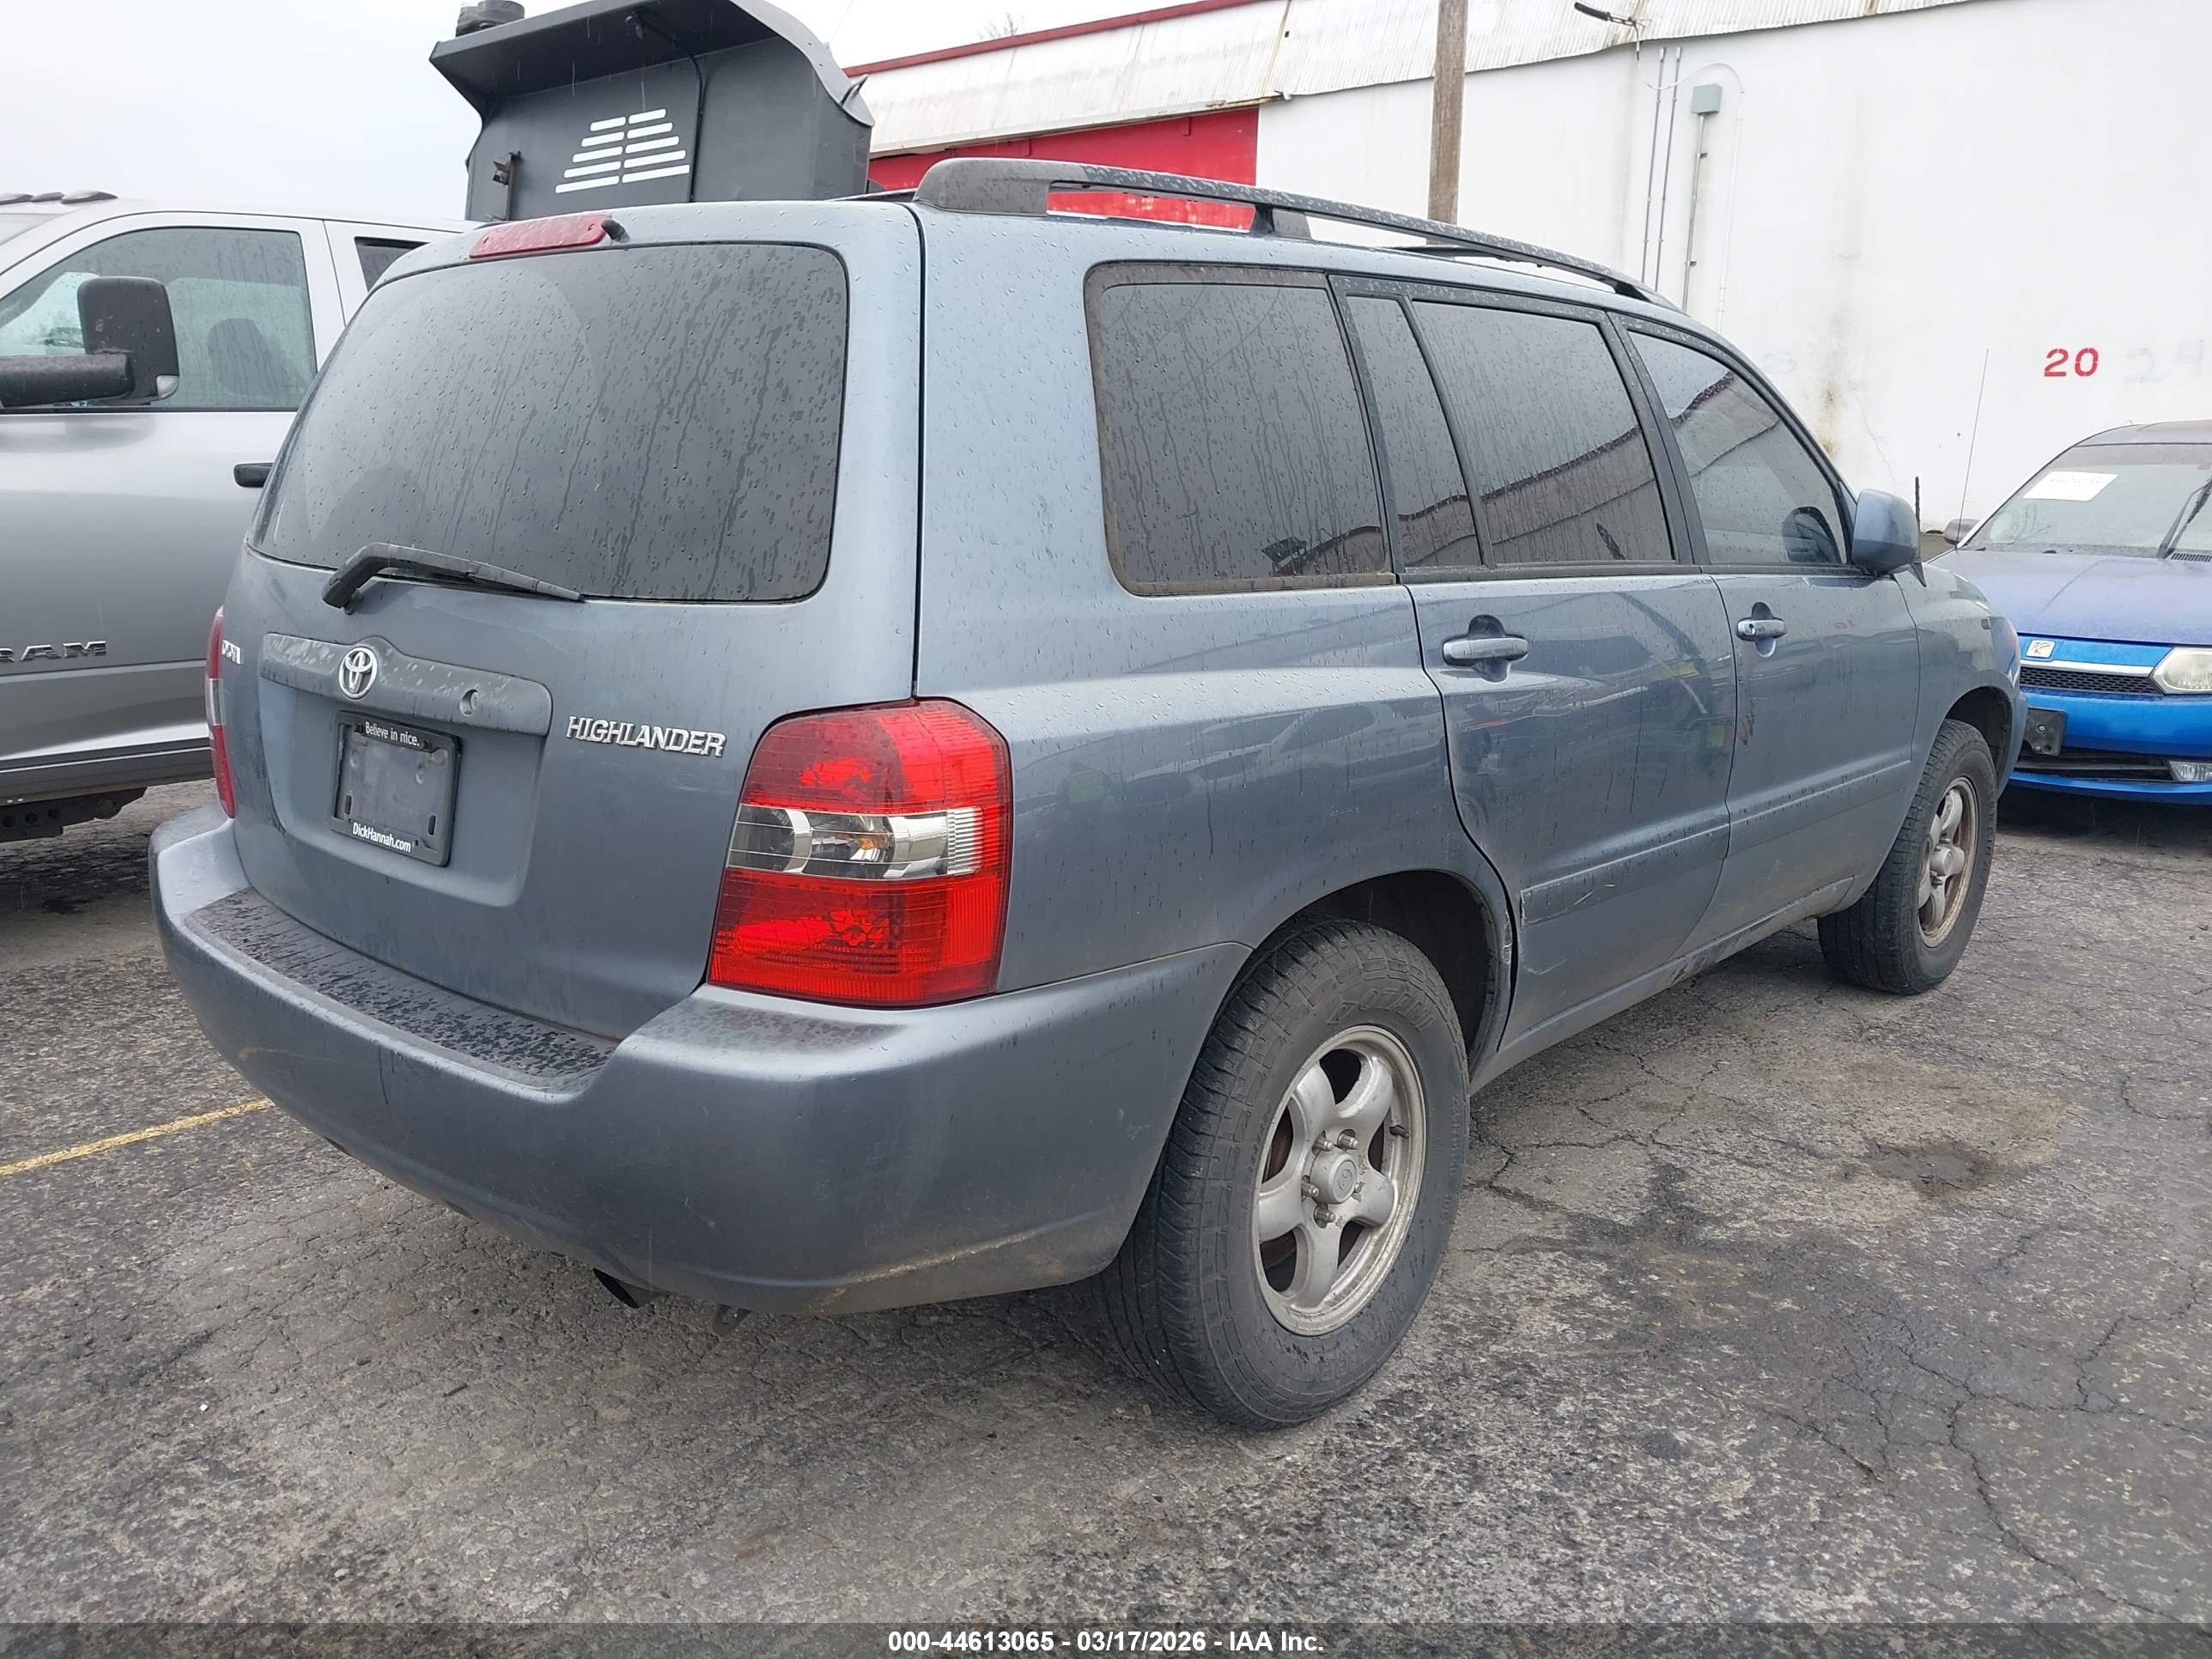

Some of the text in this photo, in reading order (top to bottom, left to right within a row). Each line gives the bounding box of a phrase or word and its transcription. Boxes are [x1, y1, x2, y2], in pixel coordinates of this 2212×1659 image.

[2044, 347, 2099, 377] 20
[365, 720, 420, 747] Believe in nice.
[565, 715, 727, 757] HIGHLANDER
[352, 822, 412, 853] DickHannah.com
